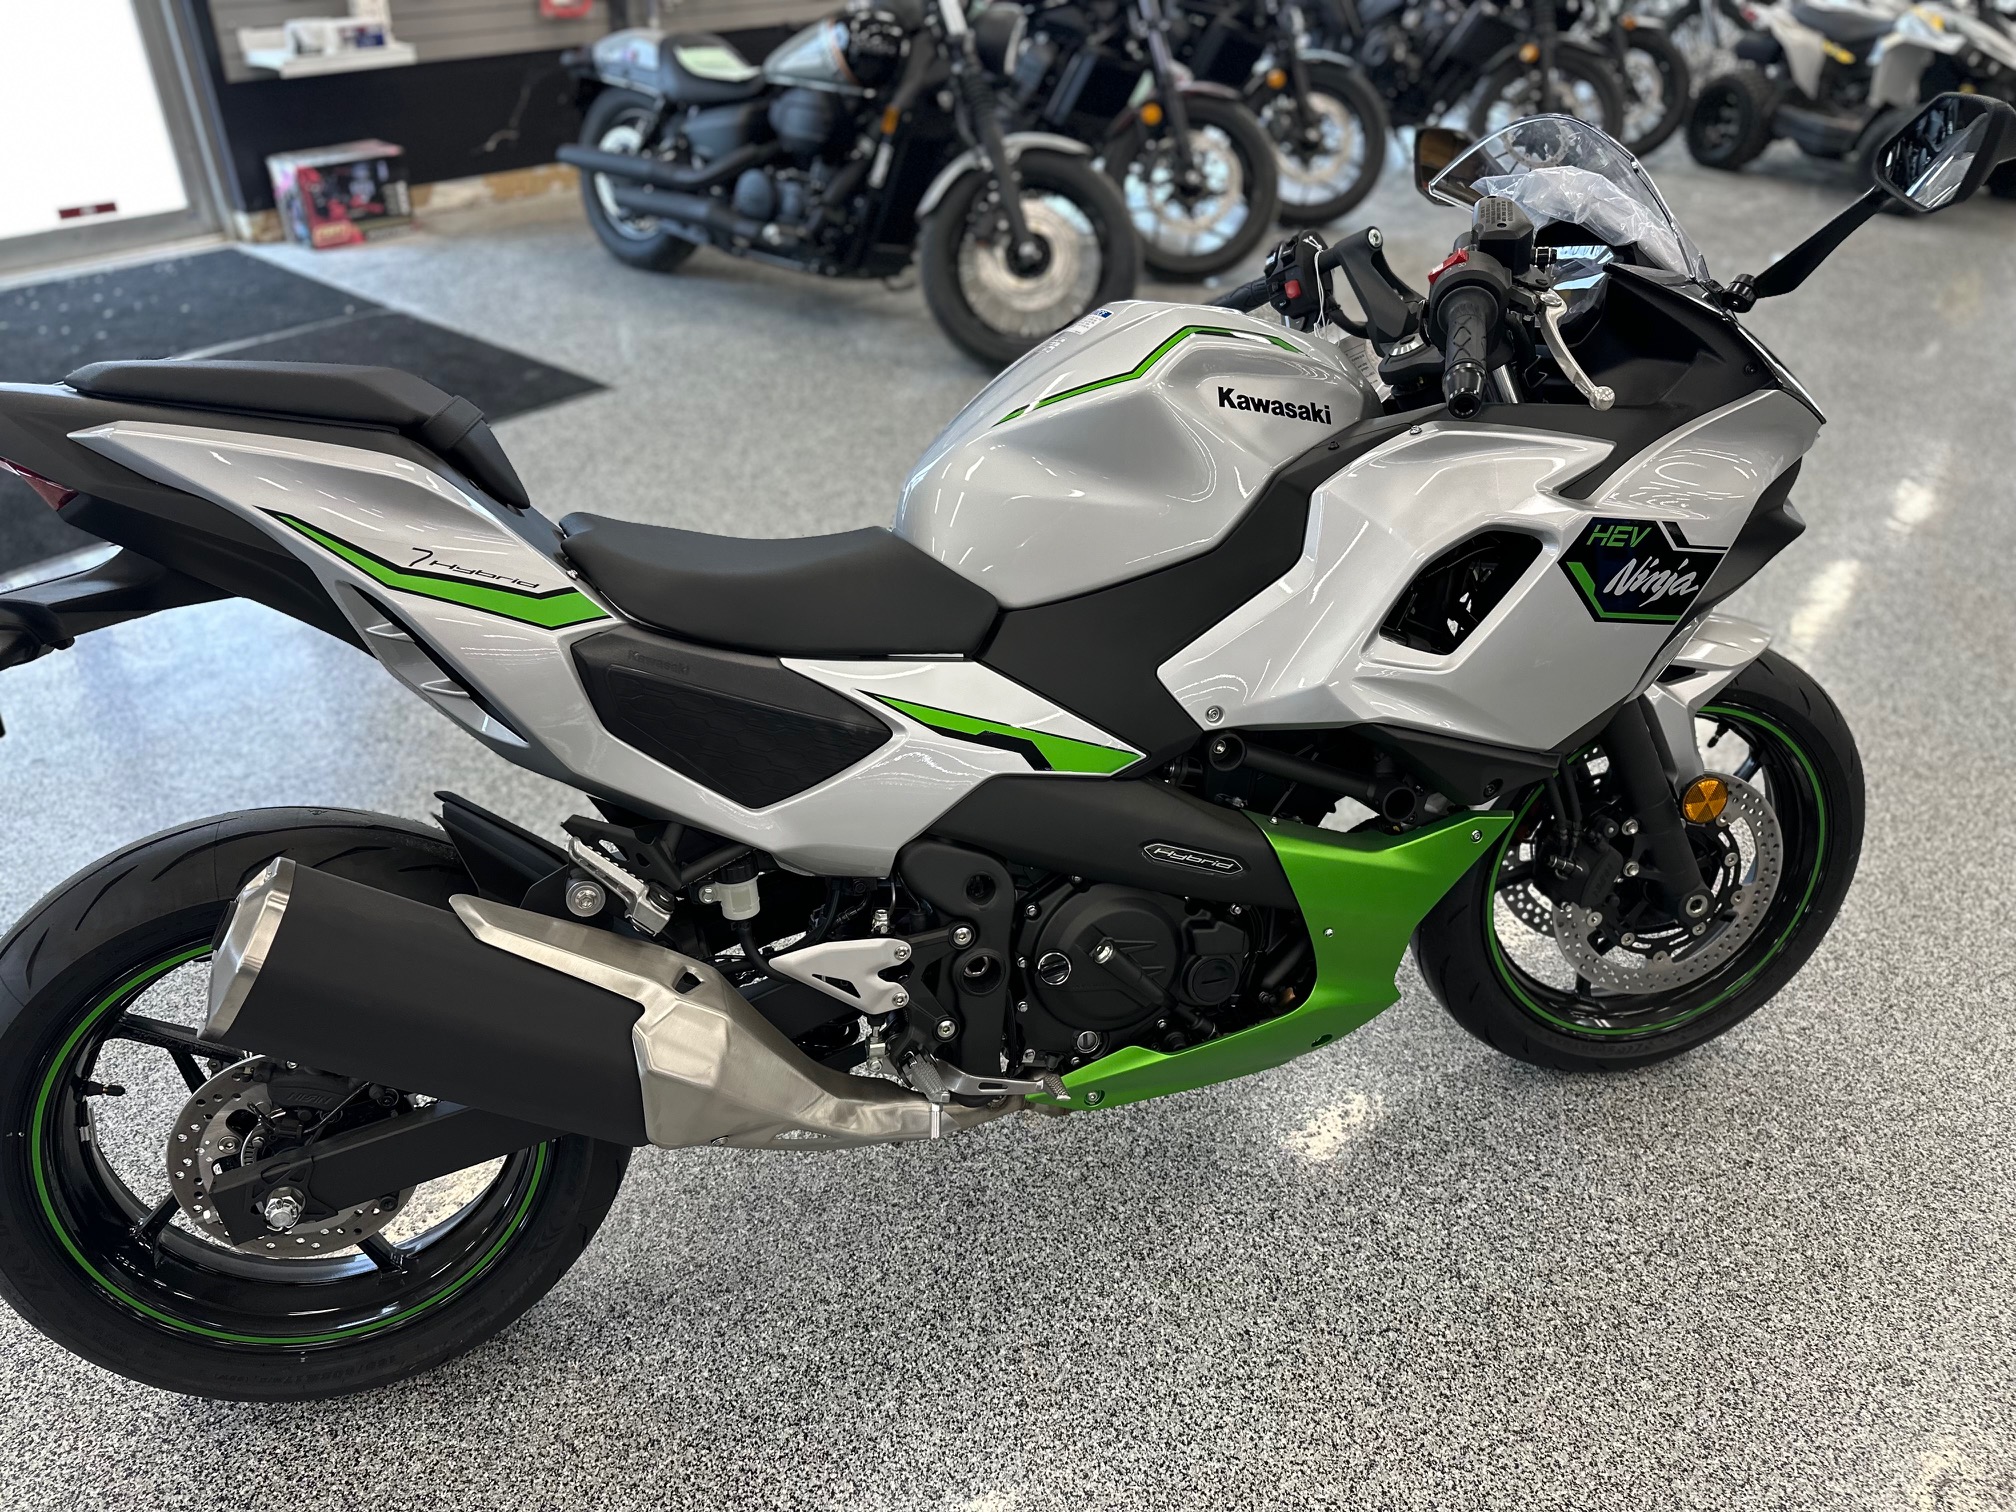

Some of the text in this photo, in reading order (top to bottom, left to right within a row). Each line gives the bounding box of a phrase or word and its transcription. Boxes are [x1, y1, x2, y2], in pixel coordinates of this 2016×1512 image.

[1217, 385, 1332, 426] Kawasaki
[1586, 524, 1652, 548] HEV
[408, 546, 540, 589] 7 Hybrid
[1602, 555, 1699, 608] Ninja
[627, 650, 690, 676] Kawasaki
[1153, 847, 1234, 870] Hybrid
